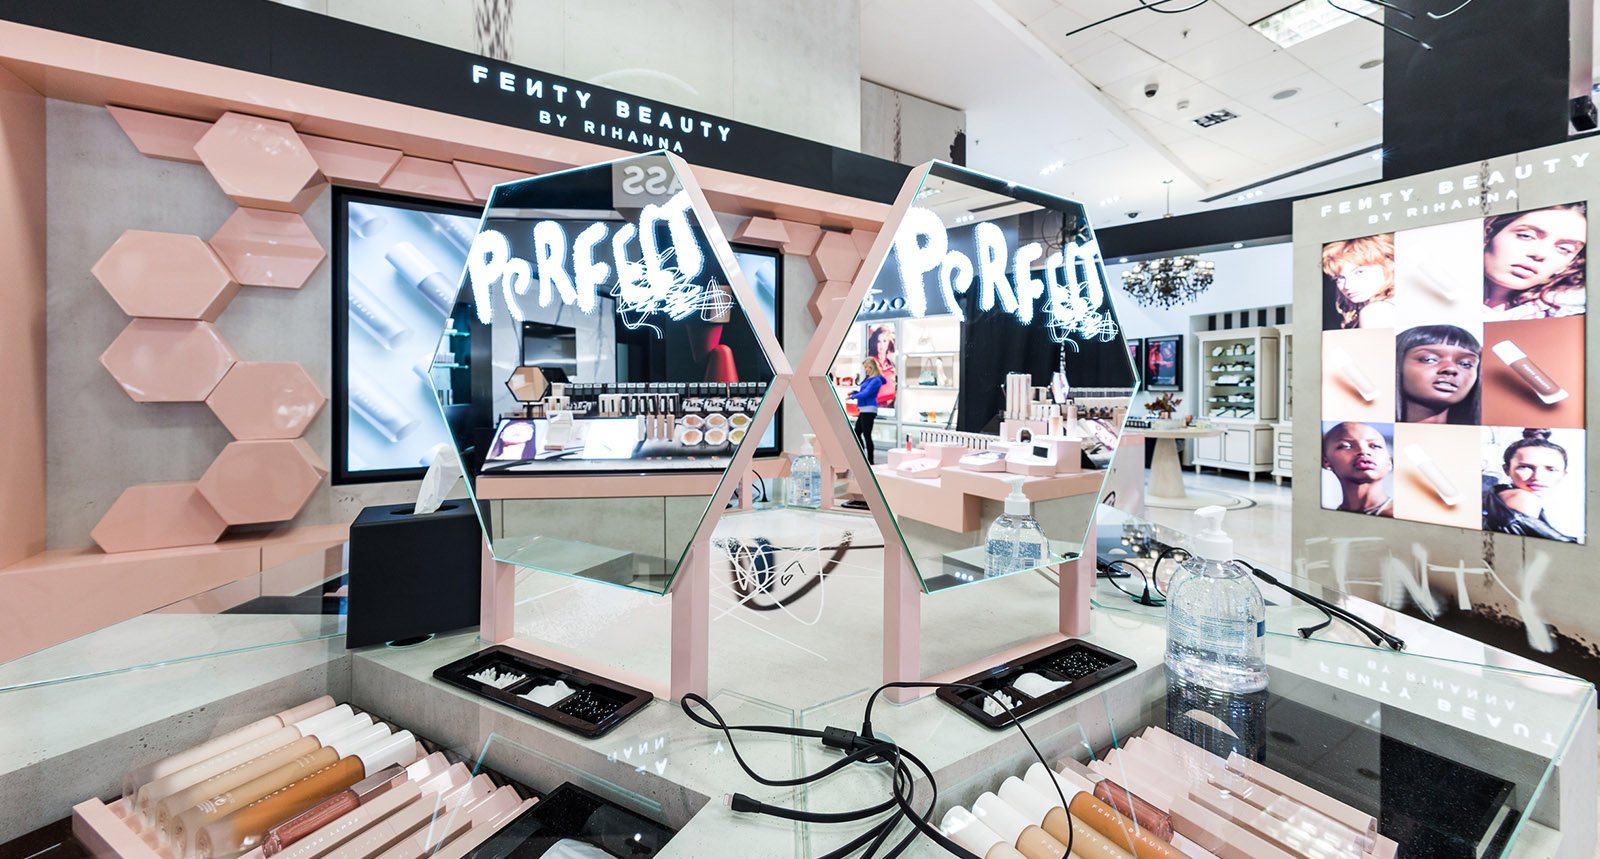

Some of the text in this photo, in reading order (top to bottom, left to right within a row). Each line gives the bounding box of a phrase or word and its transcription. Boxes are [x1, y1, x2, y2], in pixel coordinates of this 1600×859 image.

[539, 110, 683, 153] BY RIHANNA
[616, 100, 731, 142] BEAUTY
[1438, 152, 1590, 194] BEAUTY
[1368, 189, 1518, 225] BY RIHANNA
